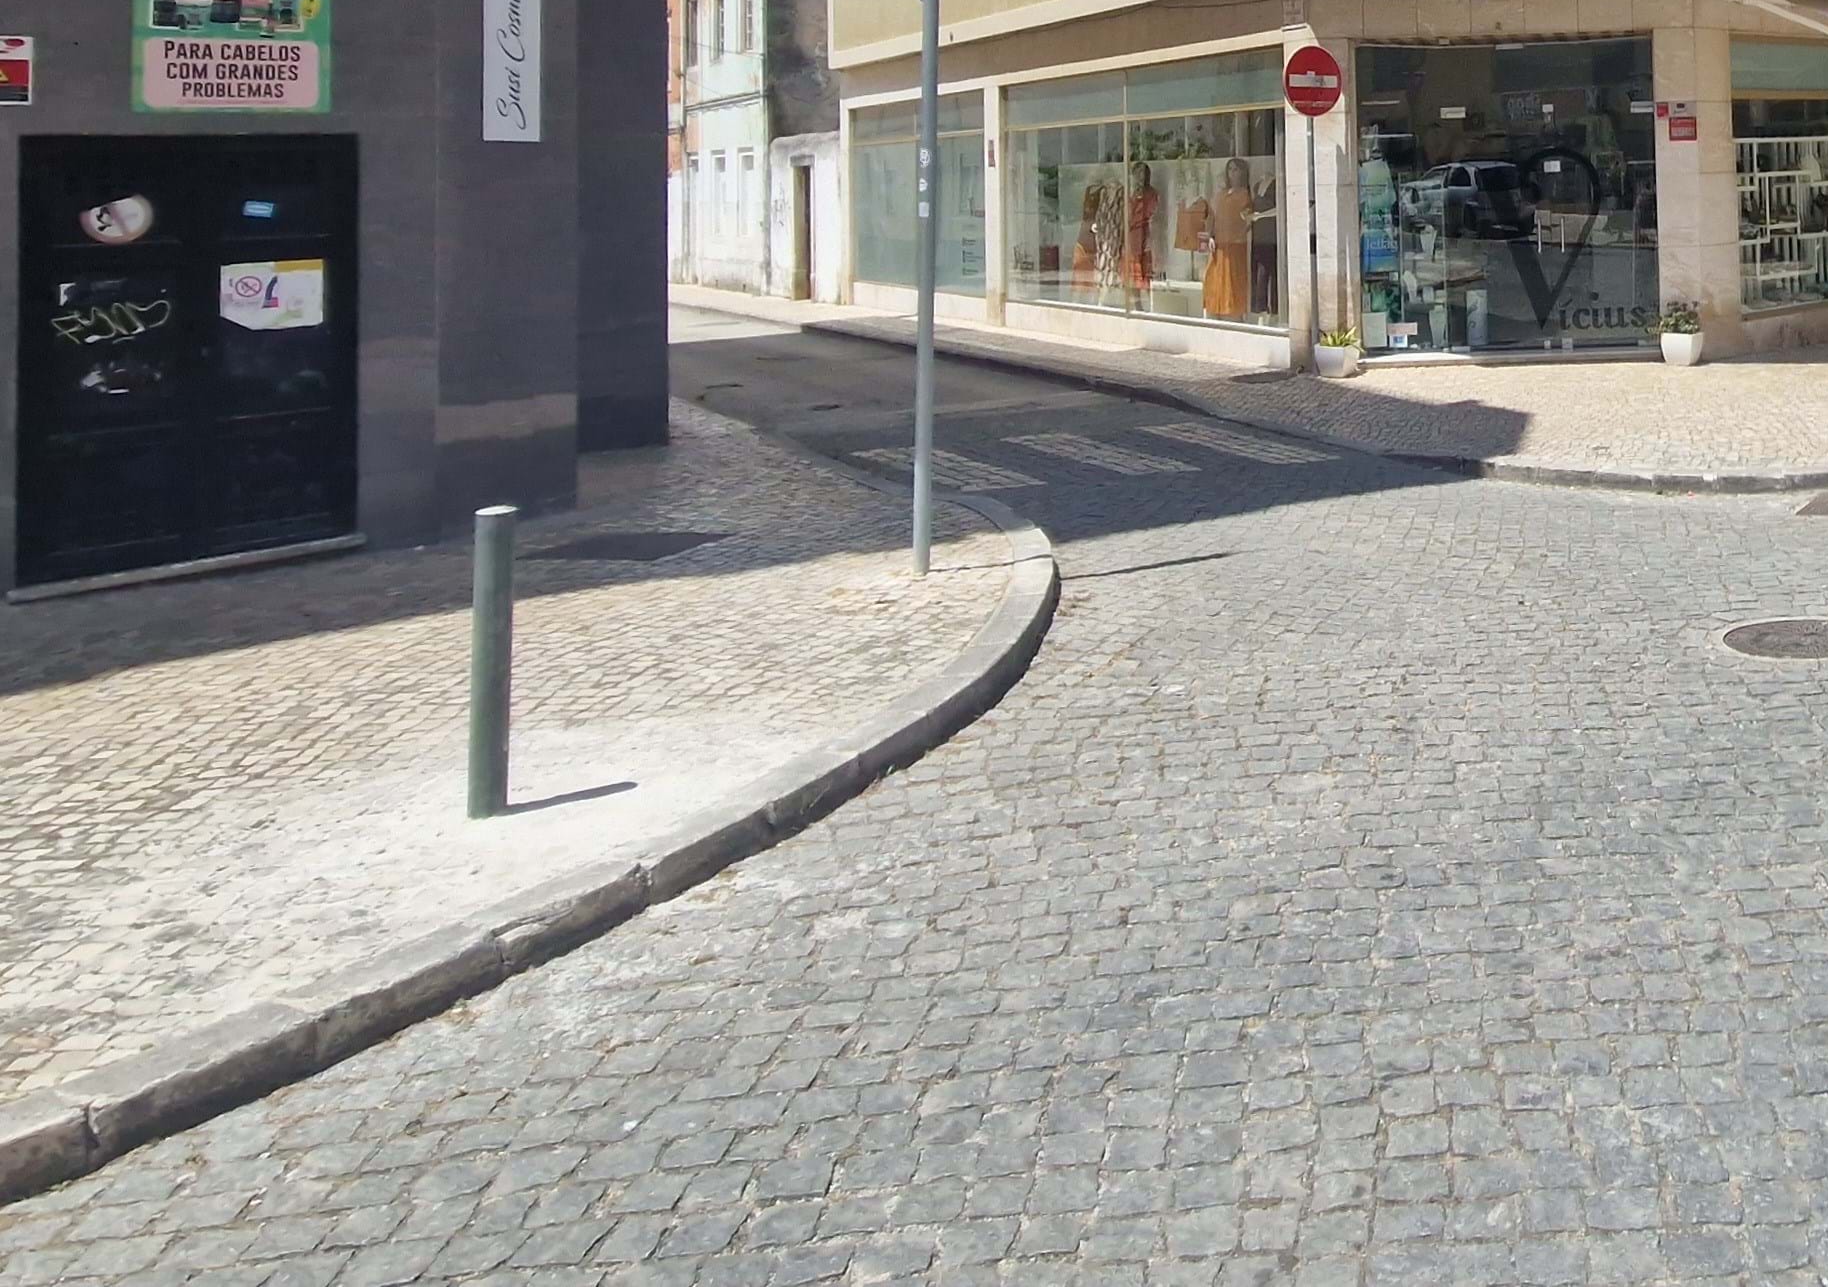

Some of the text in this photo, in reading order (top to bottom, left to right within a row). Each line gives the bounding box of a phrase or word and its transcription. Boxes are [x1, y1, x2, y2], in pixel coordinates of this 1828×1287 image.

[164, 40, 301, 62] PARA CABELOS
[166, 62, 299, 81] COM GRANDES
[181, 82, 285, 99] PROBLEMAS
[496, 67, 528, 130] Susi
